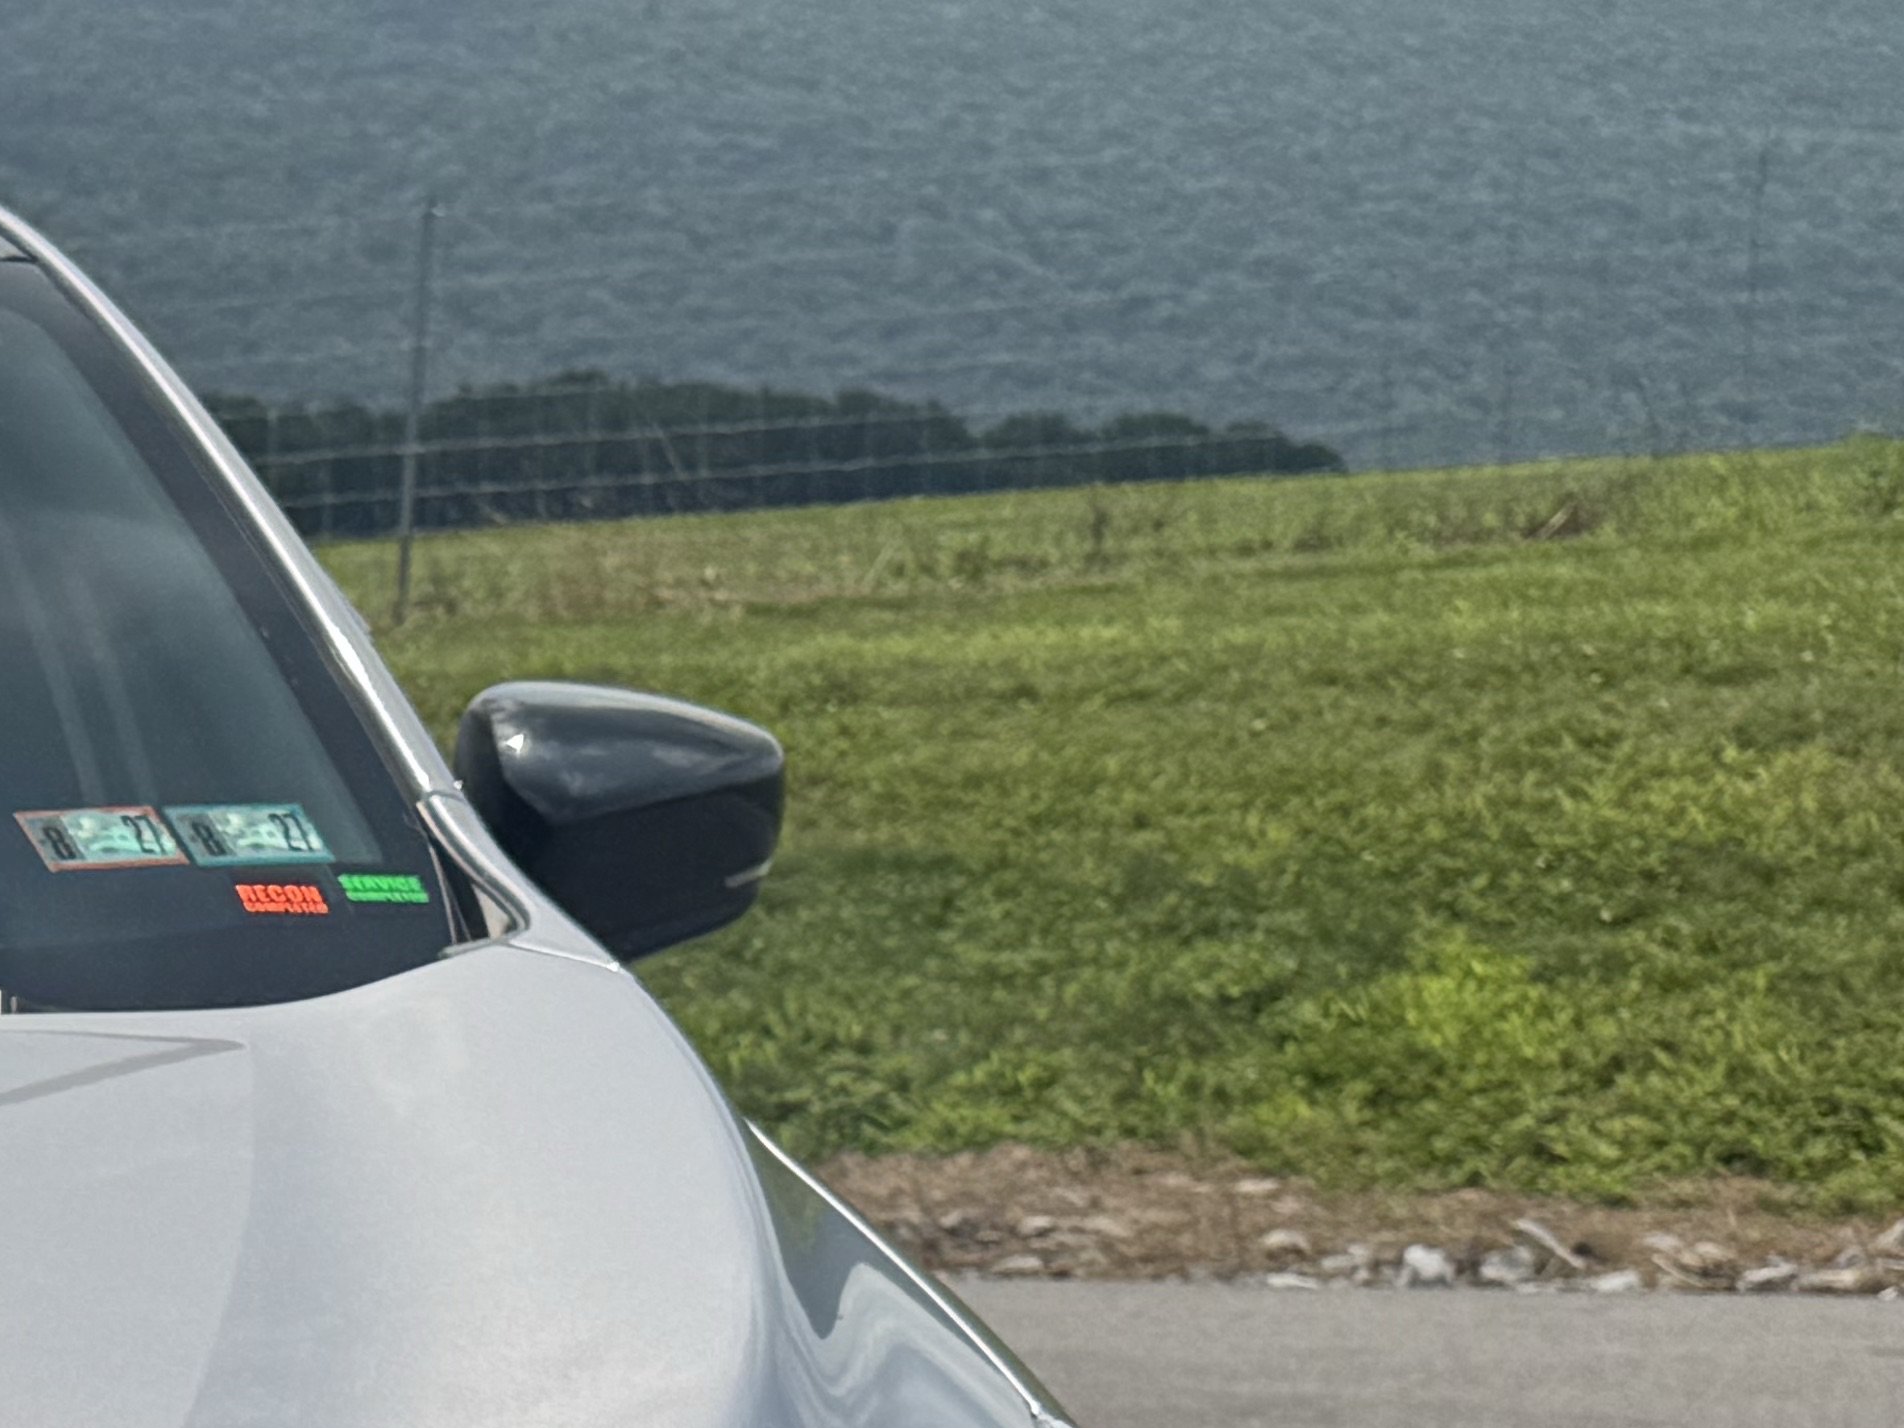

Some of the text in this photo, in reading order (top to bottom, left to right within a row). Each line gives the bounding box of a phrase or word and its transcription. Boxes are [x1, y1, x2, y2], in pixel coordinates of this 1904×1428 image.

[42, 814, 168, 861] 8 27
[268, 812, 315, 852] 27
[235, 884, 323, 902] RECON
[337, 874, 422, 890] SERVICE
